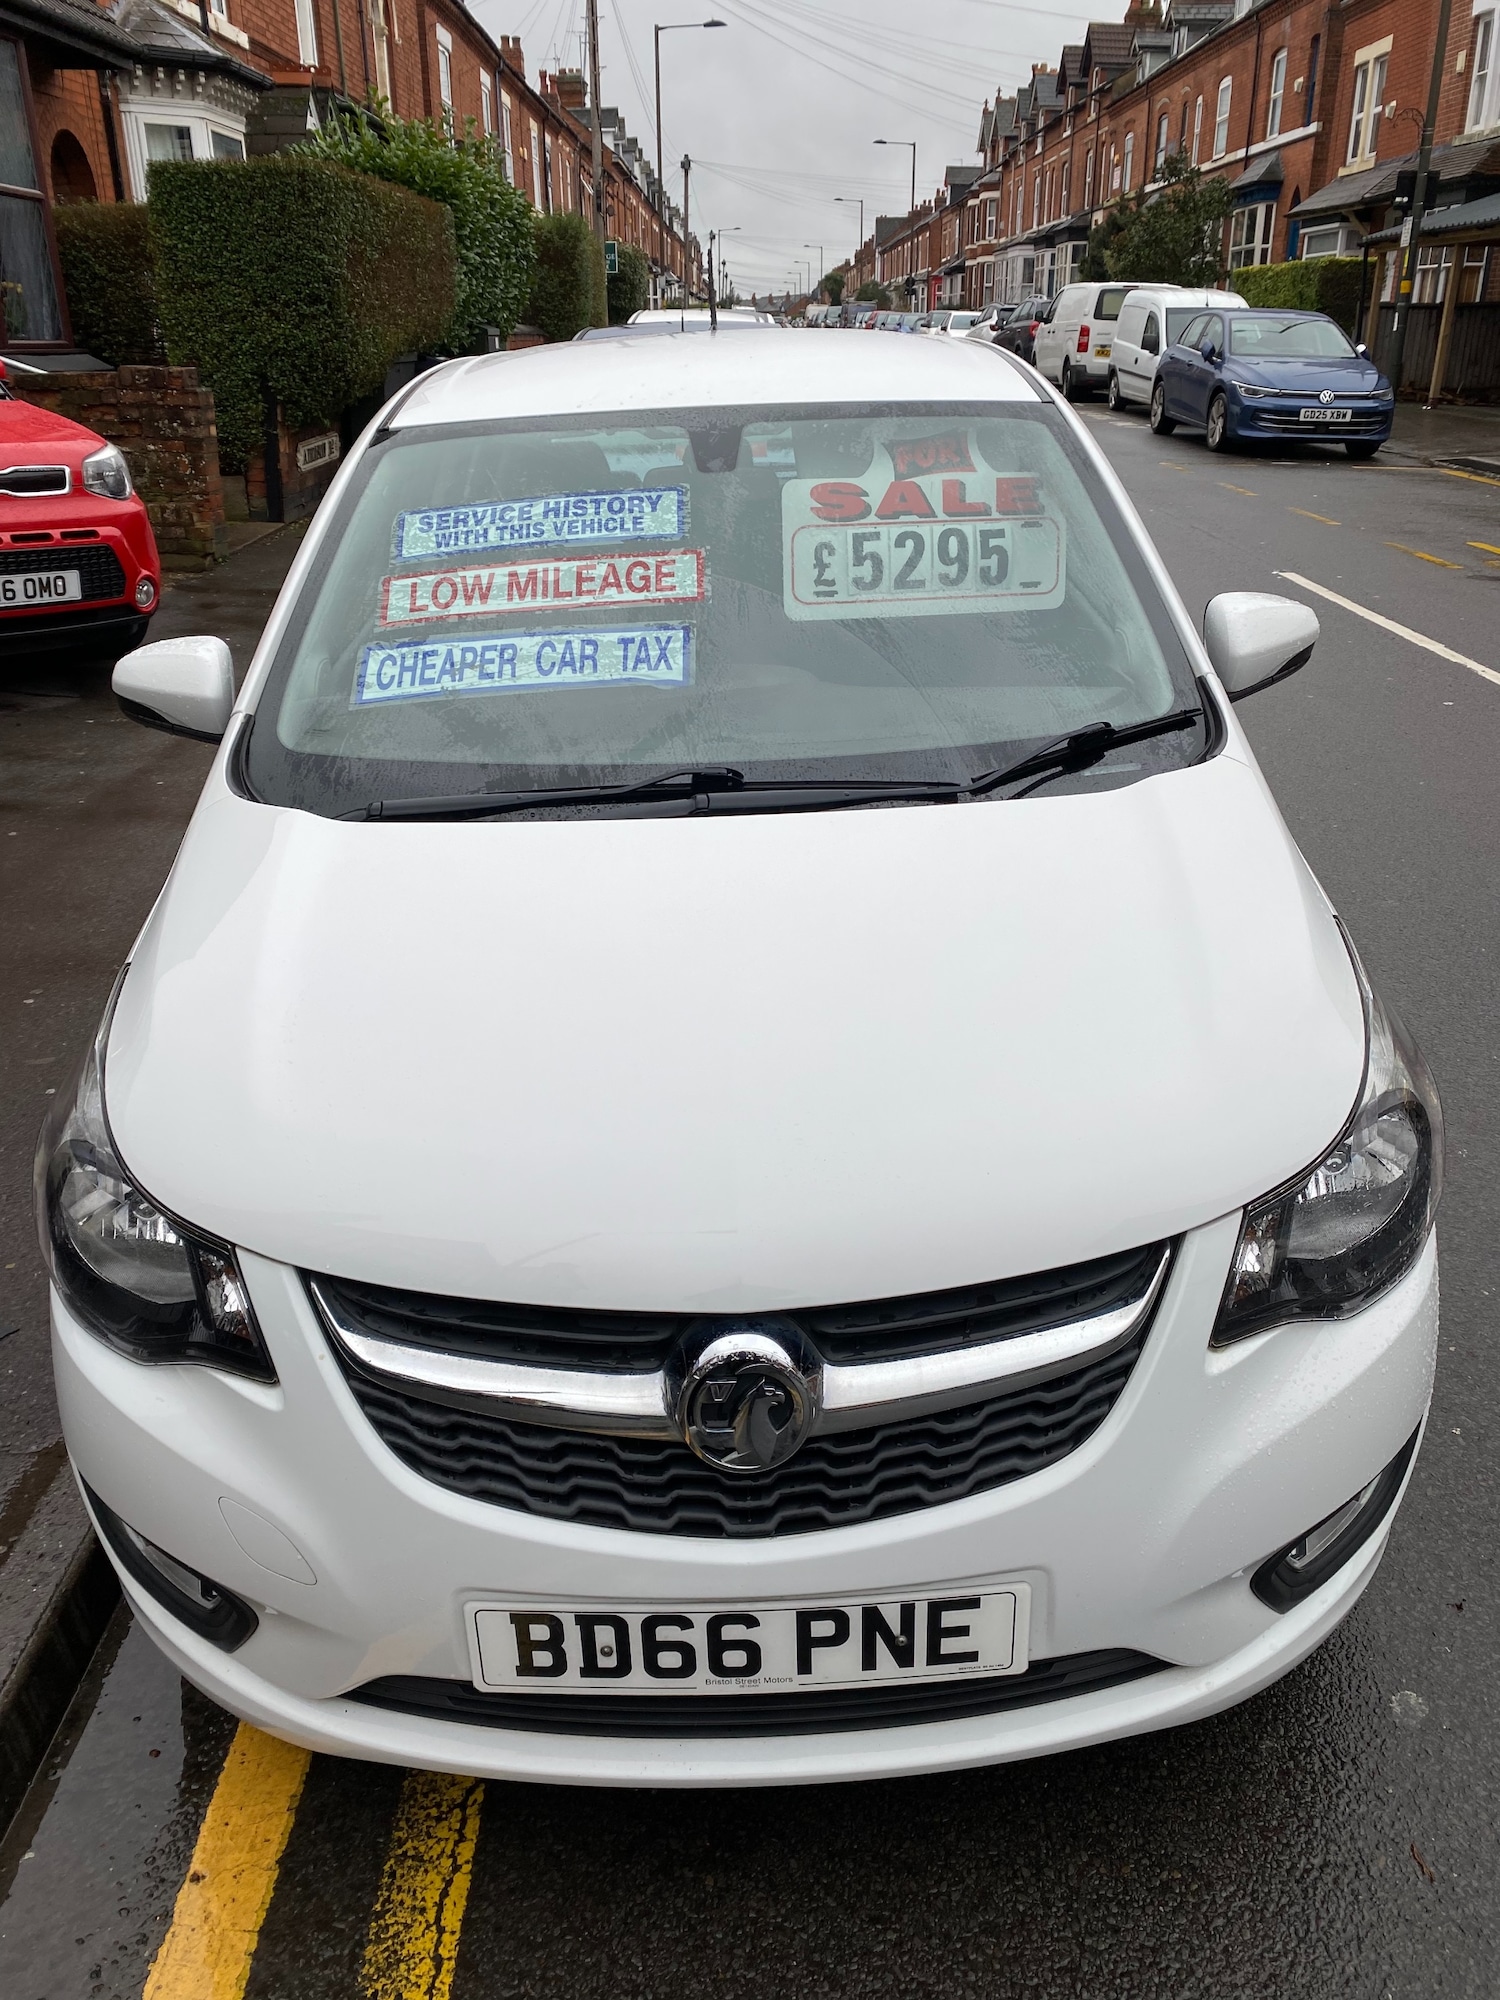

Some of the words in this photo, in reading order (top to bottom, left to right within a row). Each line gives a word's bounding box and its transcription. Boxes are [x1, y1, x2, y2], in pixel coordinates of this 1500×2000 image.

[1304, 410, 1327, 419] GD25
[1330, 410, 1348, 420] XBW
[893, 438, 962, 474] FOR
[418, 503, 533, 533] SERVICE
[542, 495, 663, 519] HISTORY
[810, 477, 1045, 522] SALE
[435, 527, 489, 549] WITH
[496, 521, 545, 541] THIS
[553, 516, 645, 537] VEHICLE
[409, 573, 495, 613] LOW
[507, 560, 677, 602] MILEAGE
[376, 644, 519, 690] CHEAPER
[536, 639, 600, 676] CAR
[618, 636, 673, 672] TAX
[508, 1612, 761, 1678] BD66
[795, 1596, 980, 1675] PNE
[705, 1678, 732, 1686] Bristol
[735, 1677, 761, 1685] Street
[763, 1676, 794, 1684] Motors
